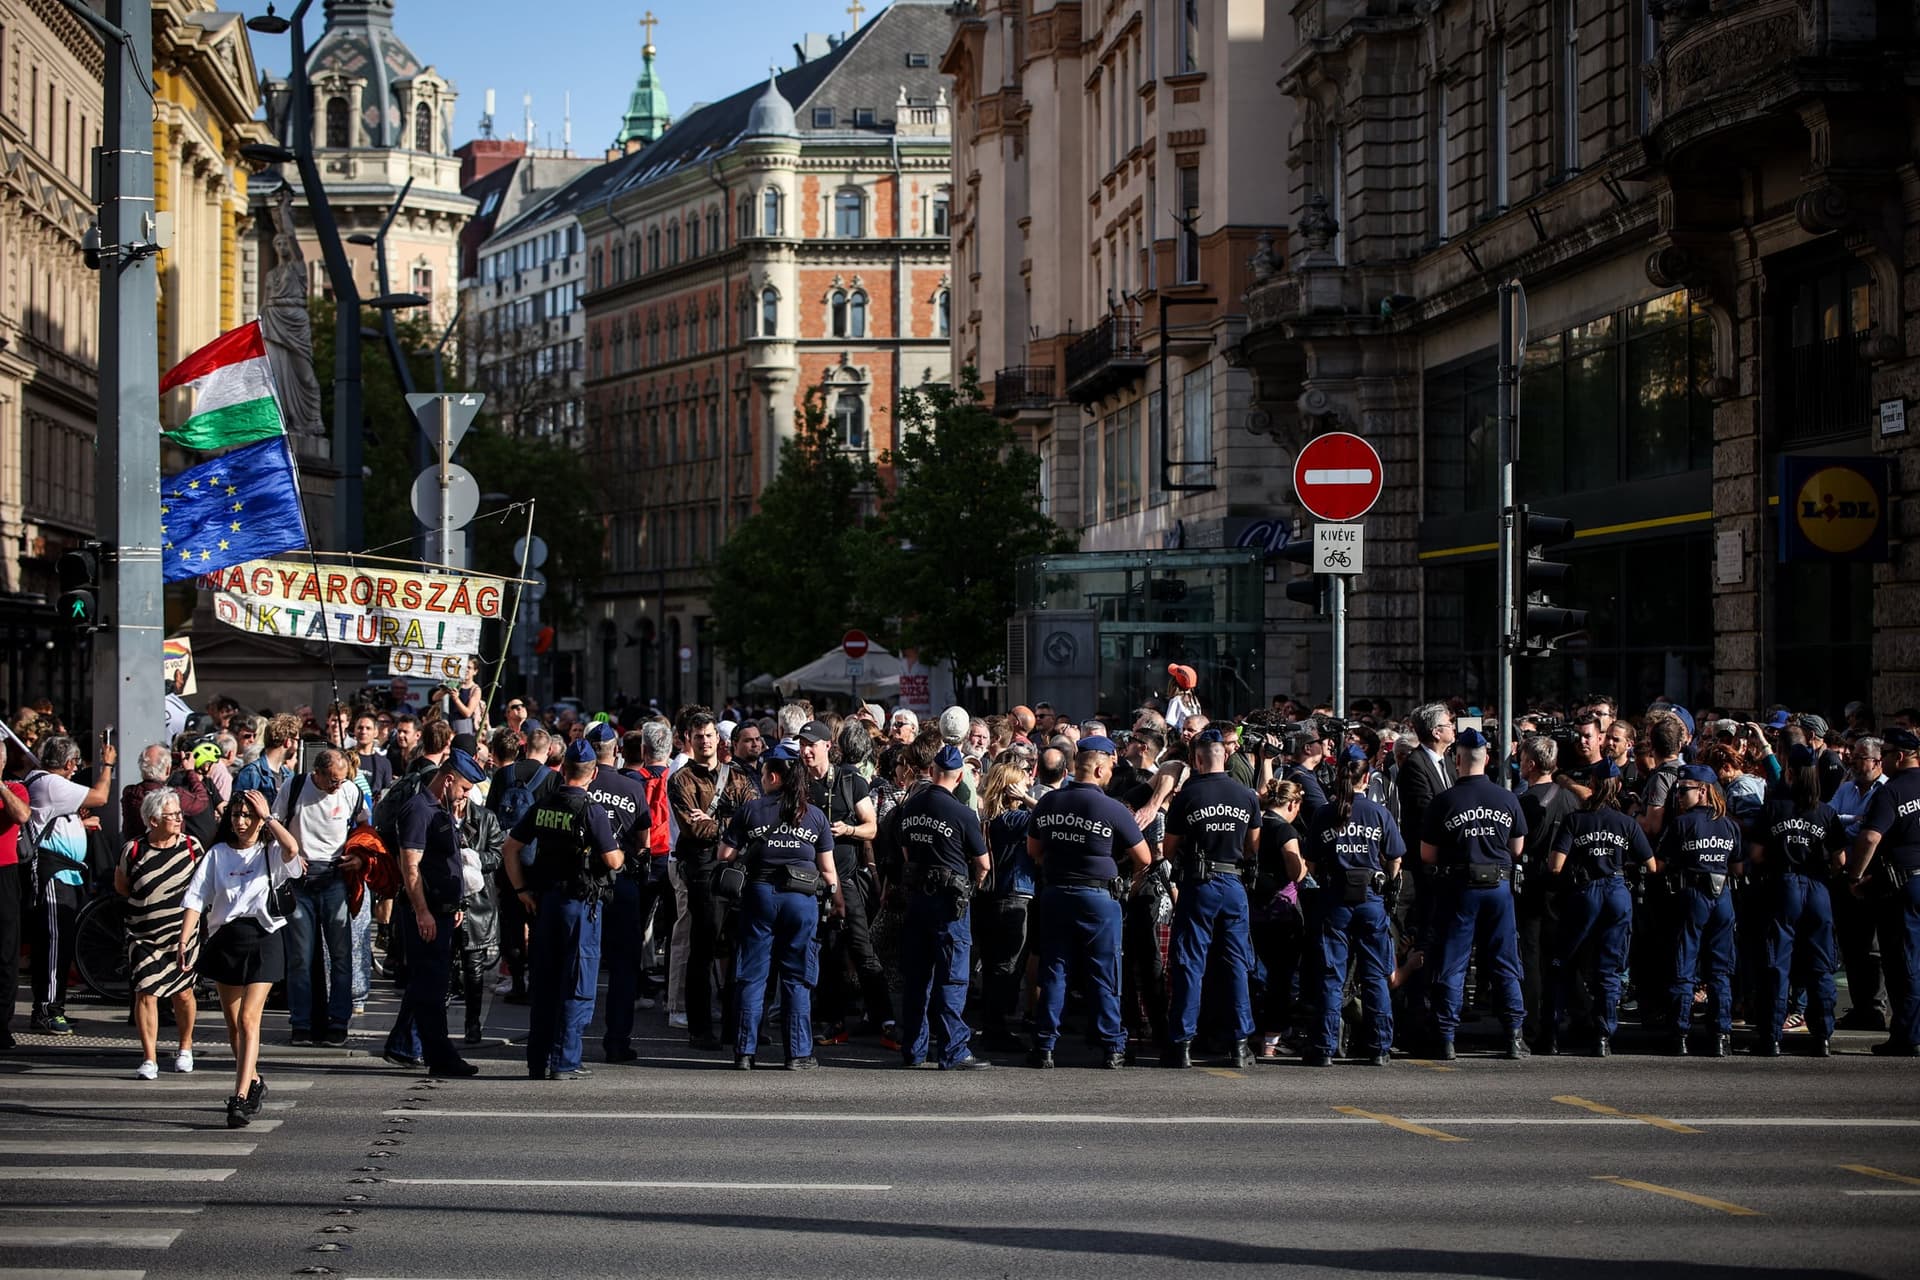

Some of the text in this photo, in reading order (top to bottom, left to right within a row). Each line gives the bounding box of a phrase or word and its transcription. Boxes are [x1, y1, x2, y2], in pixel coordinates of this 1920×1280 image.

[1320, 528, 1356, 542] KIVÉVE
[199, 564, 500, 617] MAGYARORSZÁG
[535, 808, 574, 832] BRFK
[1186, 803, 1251, 825] RENDŐRSÉG
[1444, 806, 1513, 831] RENDŐRSÉG
[902, 813, 954, 838] ENDŐRSÉG
[1206, 823, 1236, 833] POLICE
[1464, 826, 1496, 838] POLICE
[910, 833, 934, 844] POLICE
[1051, 831, 1086, 843] POLICE
[1321, 822, 1382, 844] ENDŐRSÉ
[767, 840, 801, 849] POLICE
[1336, 844, 1369, 854] POLICE
[1699, 854, 1726, 862] POLICE
